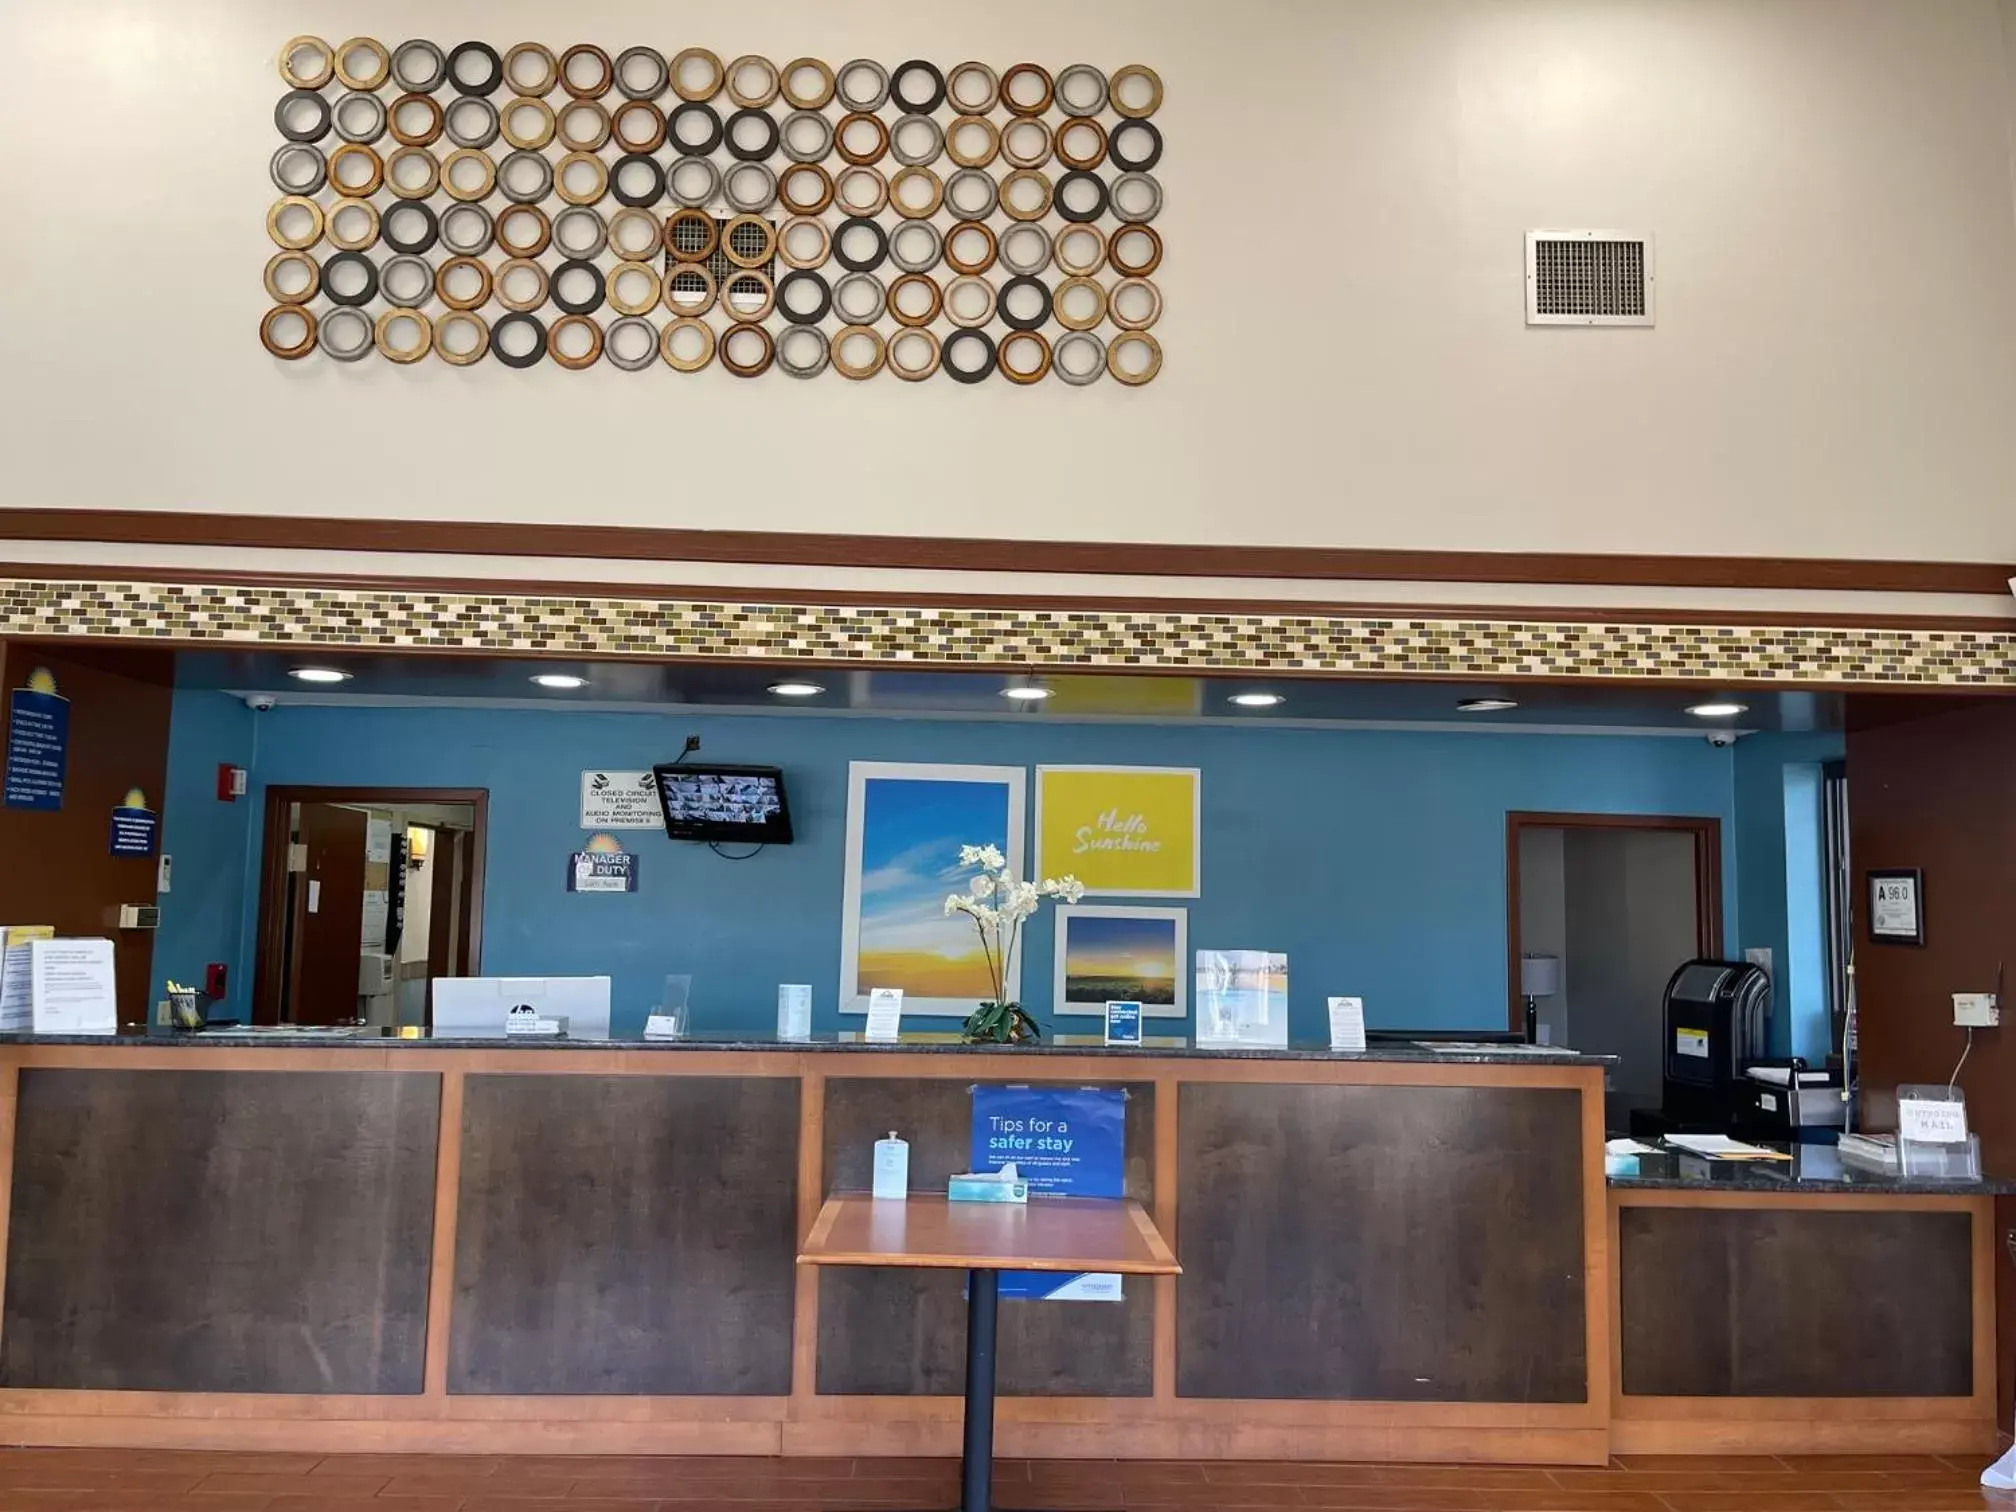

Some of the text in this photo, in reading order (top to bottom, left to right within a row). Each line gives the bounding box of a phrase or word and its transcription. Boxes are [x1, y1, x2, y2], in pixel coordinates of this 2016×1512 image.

[1097, 808, 1148, 834] Hello
[1073, 826, 1162, 854] Sunshine
[574, 854, 630, 864] MANAGER
[597, 865, 626, 874] DUTY
[1878, 886, 1886, 901] A
[989, 1116, 1068, 1134] Tips for a
[1920, 1120, 1954, 1129] MAIL
[989, 1134, 1074, 1153] safer stay
